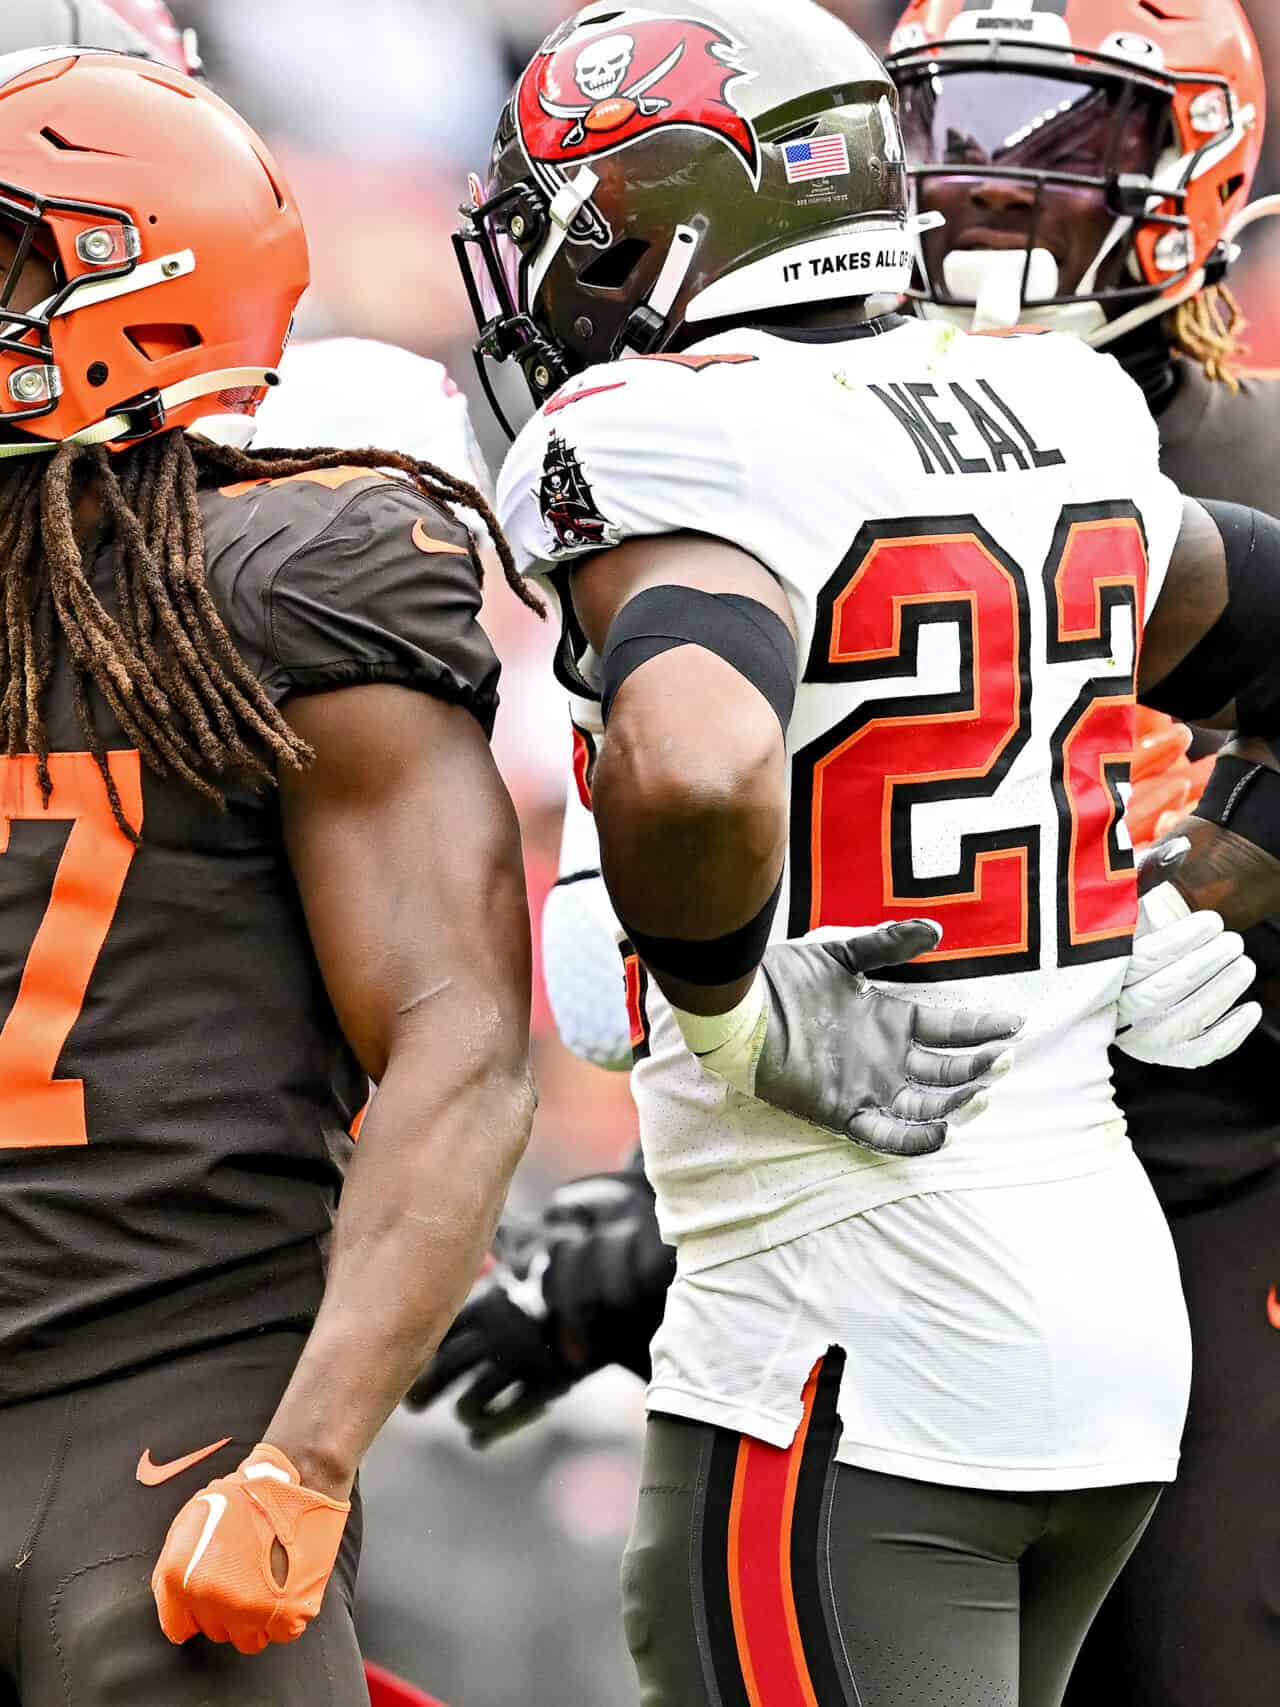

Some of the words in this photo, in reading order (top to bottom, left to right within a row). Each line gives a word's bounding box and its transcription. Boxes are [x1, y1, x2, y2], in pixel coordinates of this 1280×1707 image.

[783, 263, 802, 283] IT
[809, 251, 871, 276] TAKES
[875, 250, 897, 268] ALL
[867, 378, 1066, 474] NEAL
[787, 498, 1149, 983] 22
